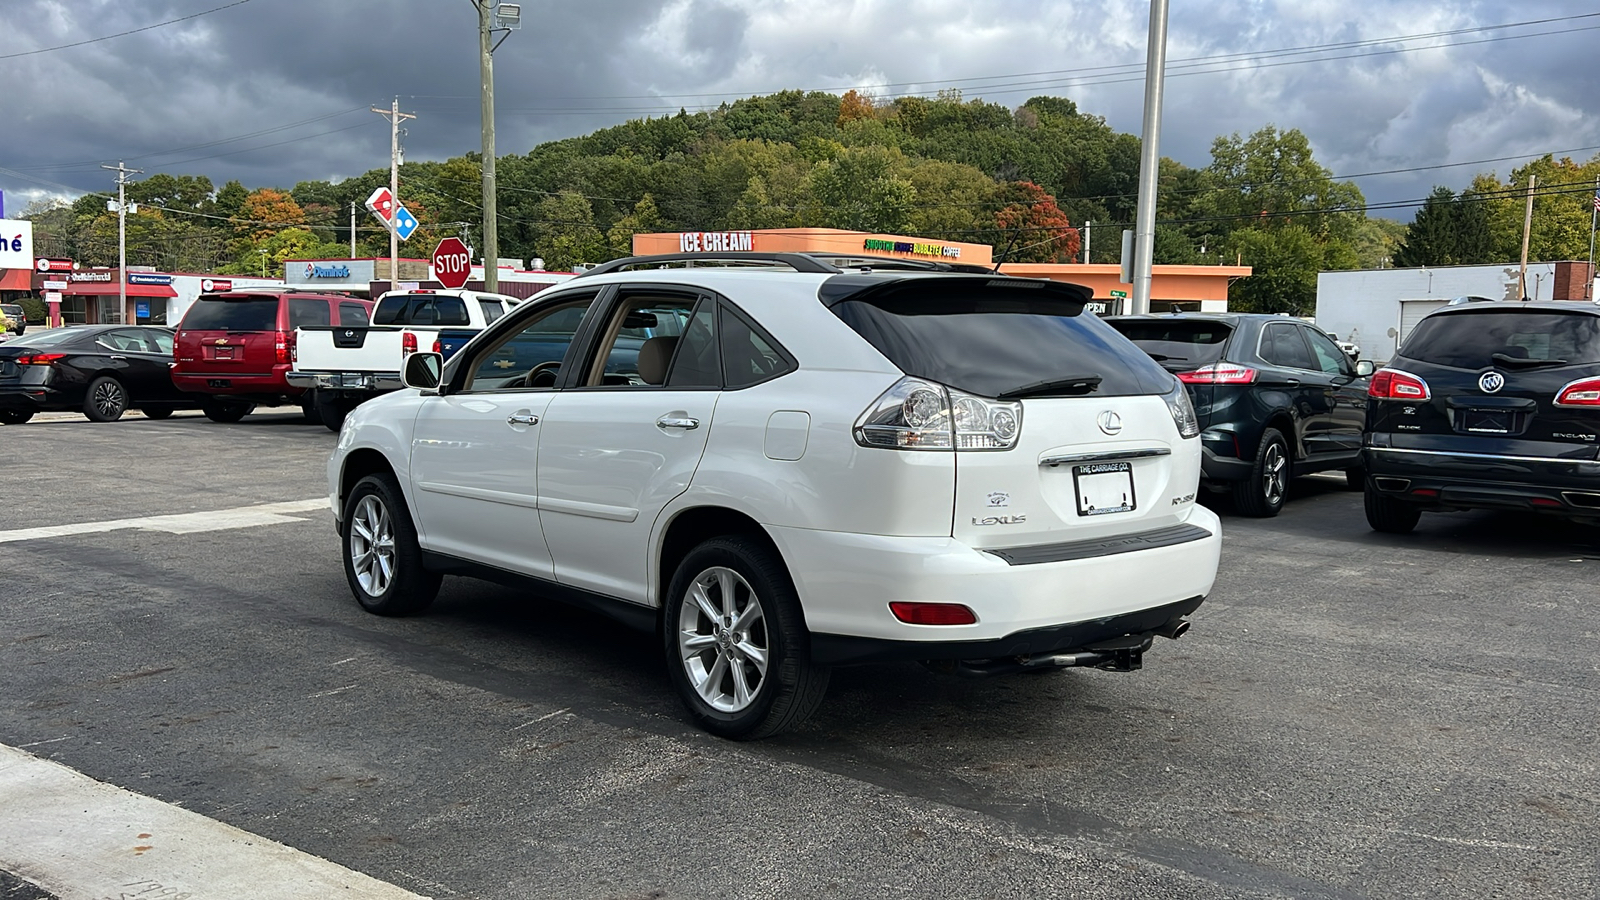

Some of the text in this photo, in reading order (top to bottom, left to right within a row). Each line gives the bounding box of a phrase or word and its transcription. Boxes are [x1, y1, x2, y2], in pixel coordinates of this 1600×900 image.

[680, 231, 753, 252] ICE CREAM
[865, 239, 894, 250] SMOOTHIE
[943, 246, 960, 257] COFFEE
[436, 253, 468, 274] STOP
[314, 265, 350, 278] Domino's
[1084, 302, 1106, 314] PEN
[1080, 465, 1091, 473] THE
[1091, 463, 1118, 472] CARRIAGE
[971, 514, 1027, 526] LEXUS
